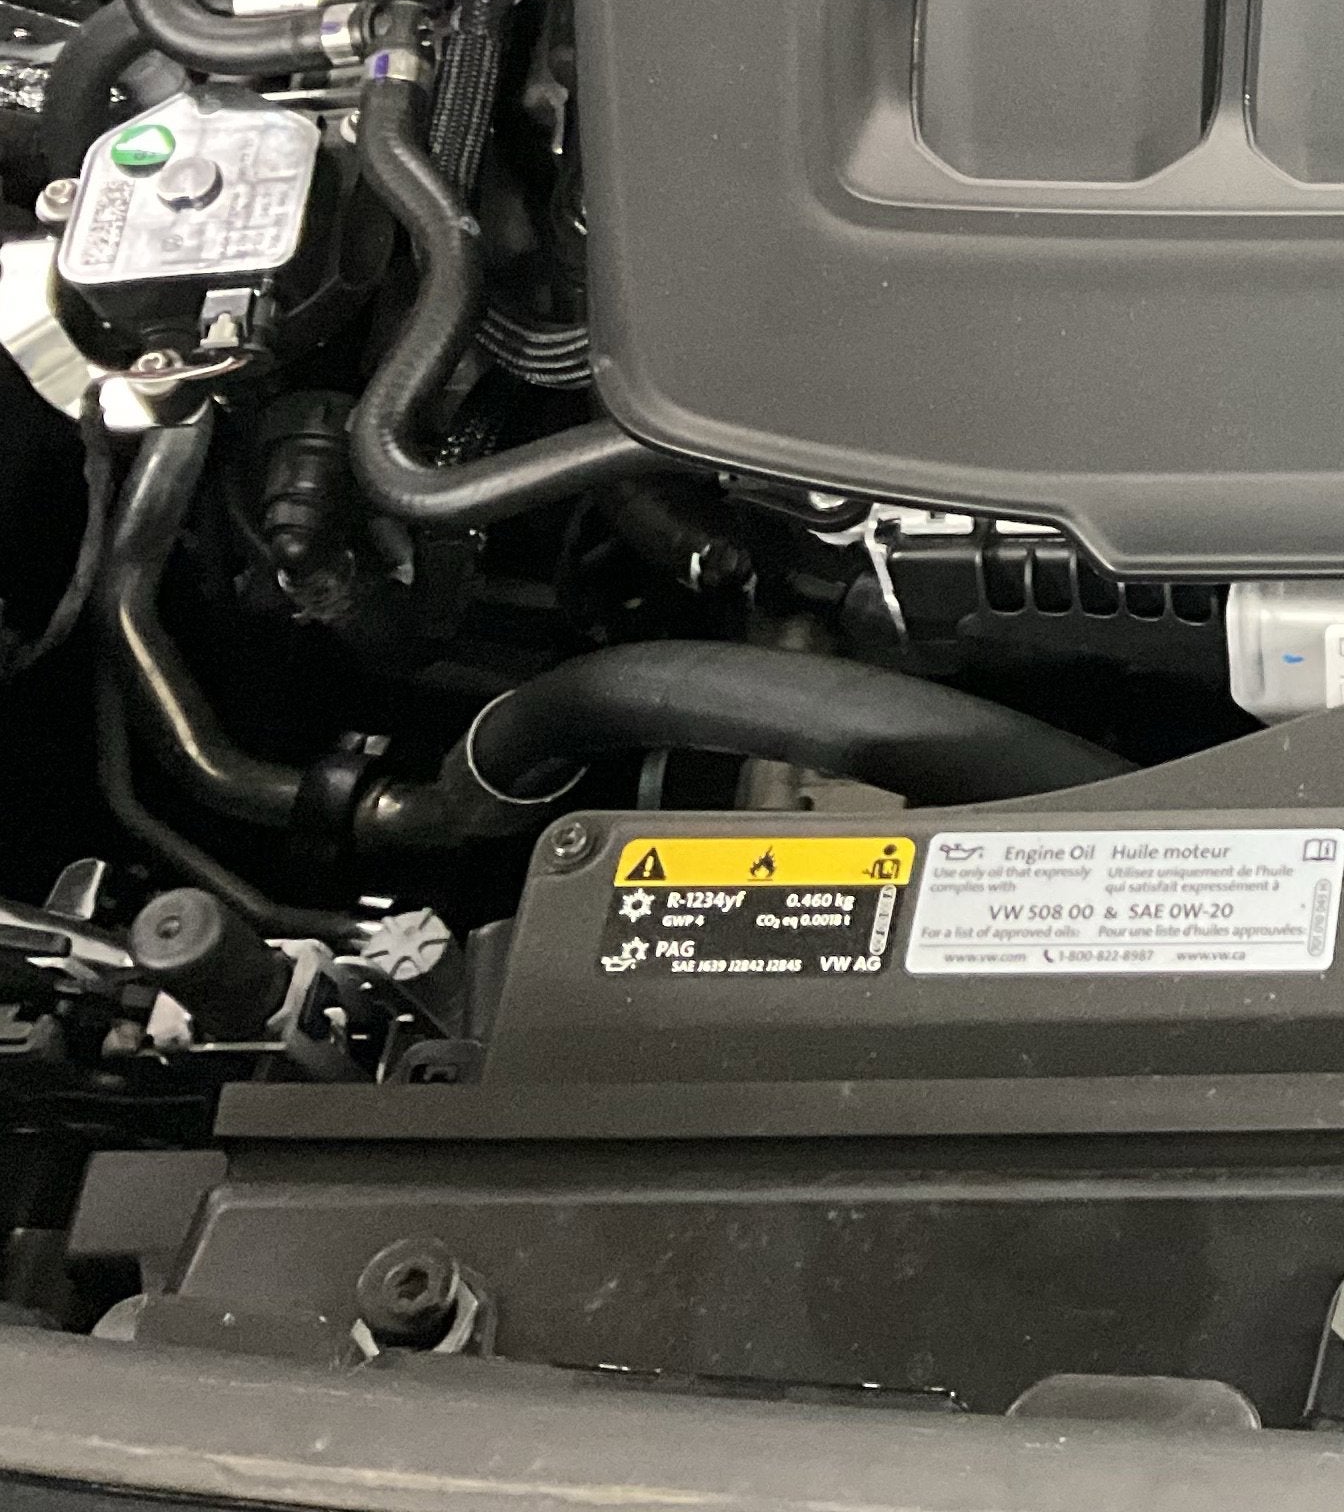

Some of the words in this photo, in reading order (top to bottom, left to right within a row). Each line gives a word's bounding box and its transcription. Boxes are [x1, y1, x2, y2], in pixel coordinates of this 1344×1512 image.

[1004, 845, 1066, 865] Engine
[1069, 844, 1096, 860] Oil
[1111, 844, 1159, 860] Huile
[1163, 845, 1232, 860] moteur
[933, 867, 955, 879] Use
[960, 867, 985, 883] only
[987, 866, 1004, 879] oil
[1005, 866, 1033, 879] that
[1034, 866, 1092, 882] expressly
[1107, 864, 1153, 878] Utilisez
[1156, 865, 1234, 882] uniquement
[1236, 865, 1254, 877] de
[1255, 864, 1294, 877] l'huile
[929, 881, 985, 896] complies
[987, 881, 1017, 893] with
[1104, 880, 1126, 895] qui
[1127, 879, 1178, 893] satisfait
[1181, 879, 1269, 896] expressément
[666, 891, 747, 913] R-1234yf
[785, 893, 833, 909] 0.460
[834, 893, 856, 911] kg
[989, 904, 1025, 920] VW
[1027, 904, 1064, 920] 508
[1067, 904, 1095, 920] 00
[1103, 905, 1118, 920] &
[1128, 903, 1164, 920] SAE
[1168, 903, 1235, 920] 0W-20
[661, 914, 693, 928] GWP
[694, 915, 705, 927] 4
[781, 917, 799, 930] eq
[843, 915, 852, 926] t
[920, 926, 942, 939] For
[943, 929, 953, 939] a
[954, 926, 974, 939] list
[976, 926, 990, 939] of
[991, 926, 1051, 941] approved
[1053, 926, 1081, 938] oils:
[1098, 924, 1127, 937] Pour
[1128, 926, 1153, 937] une
[1154, 924, 1180, 937] liste
[1182, 923, 1230, 937] d'huiles
[654, 939, 696, 958] PAG
[943, 952, 1027, 963] www.vw.com
[1058, 949, 1155, 963] 1-800-822-8987
[1176, 950, 1246, 962] www.vw.ca
[671, 960, 696, 973] SAE
[819, 956, 853, 972] VW
[852, 955, 883, 972] AG
